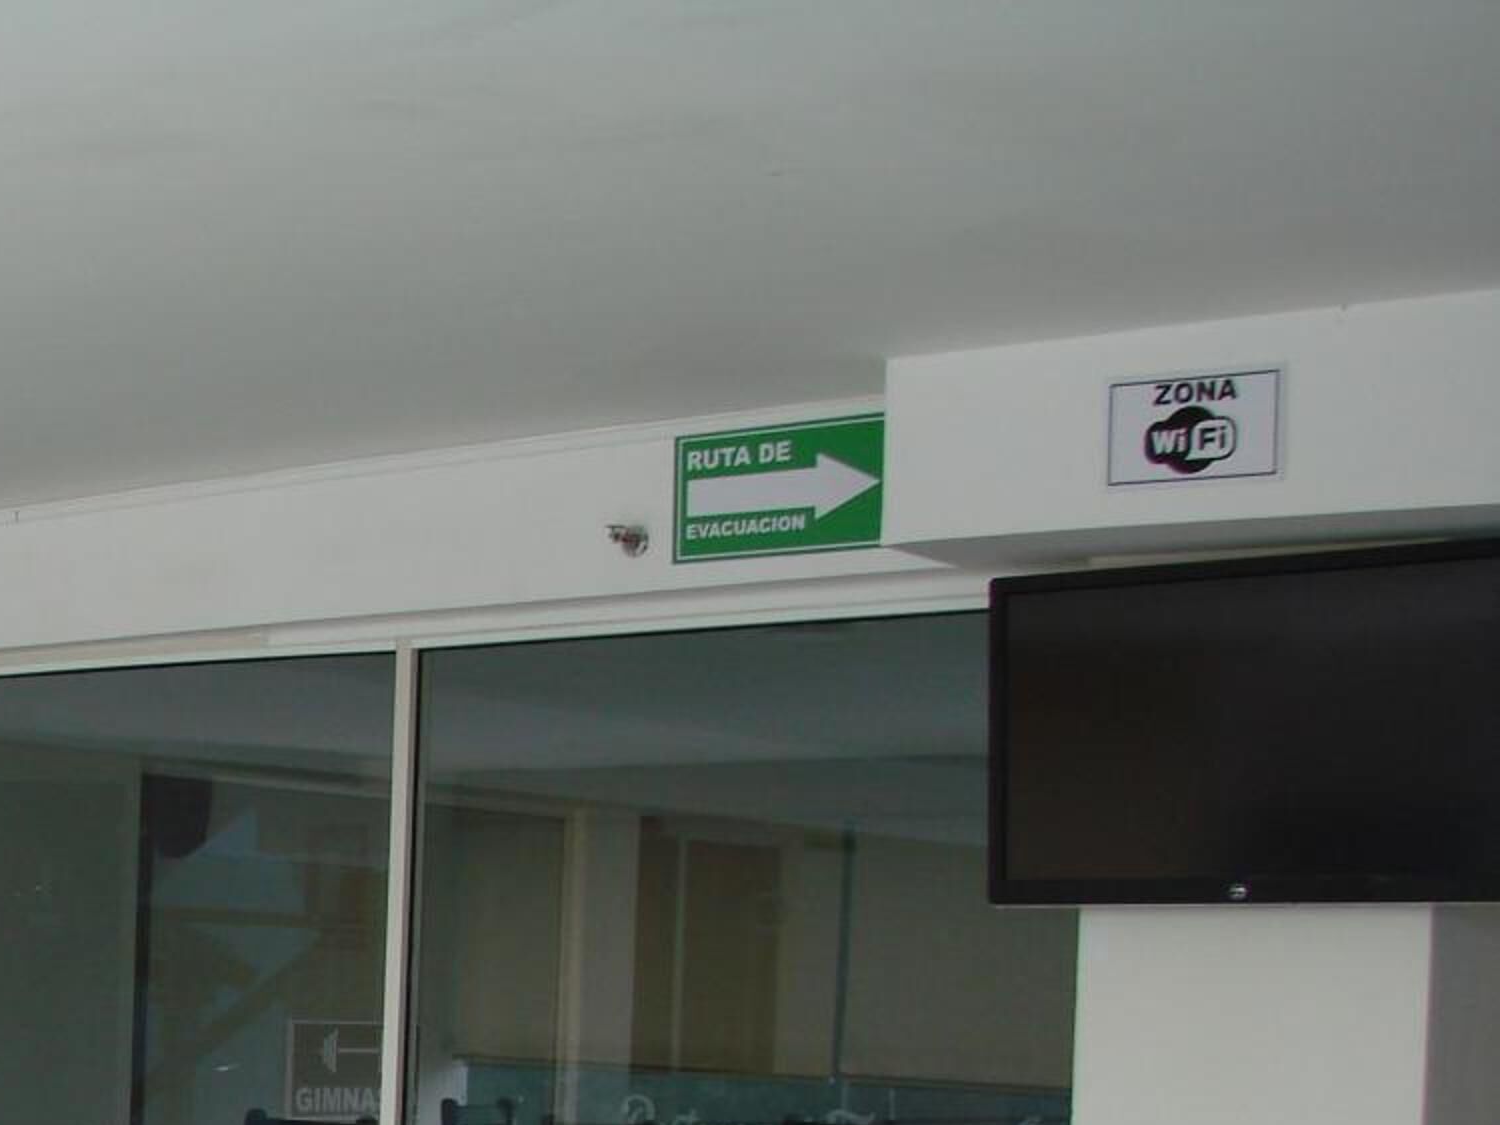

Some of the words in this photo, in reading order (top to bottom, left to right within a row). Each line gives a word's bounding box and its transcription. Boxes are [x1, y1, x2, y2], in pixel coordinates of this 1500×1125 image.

[1153, 379, 1238, 406] ZONA
[1150, 423, 1227, 457] WiFi
[687, 445, 751, 472] RUTA
[759, 439, 792, 464] DE
[685, 514, 806, 540] EVACUACION
